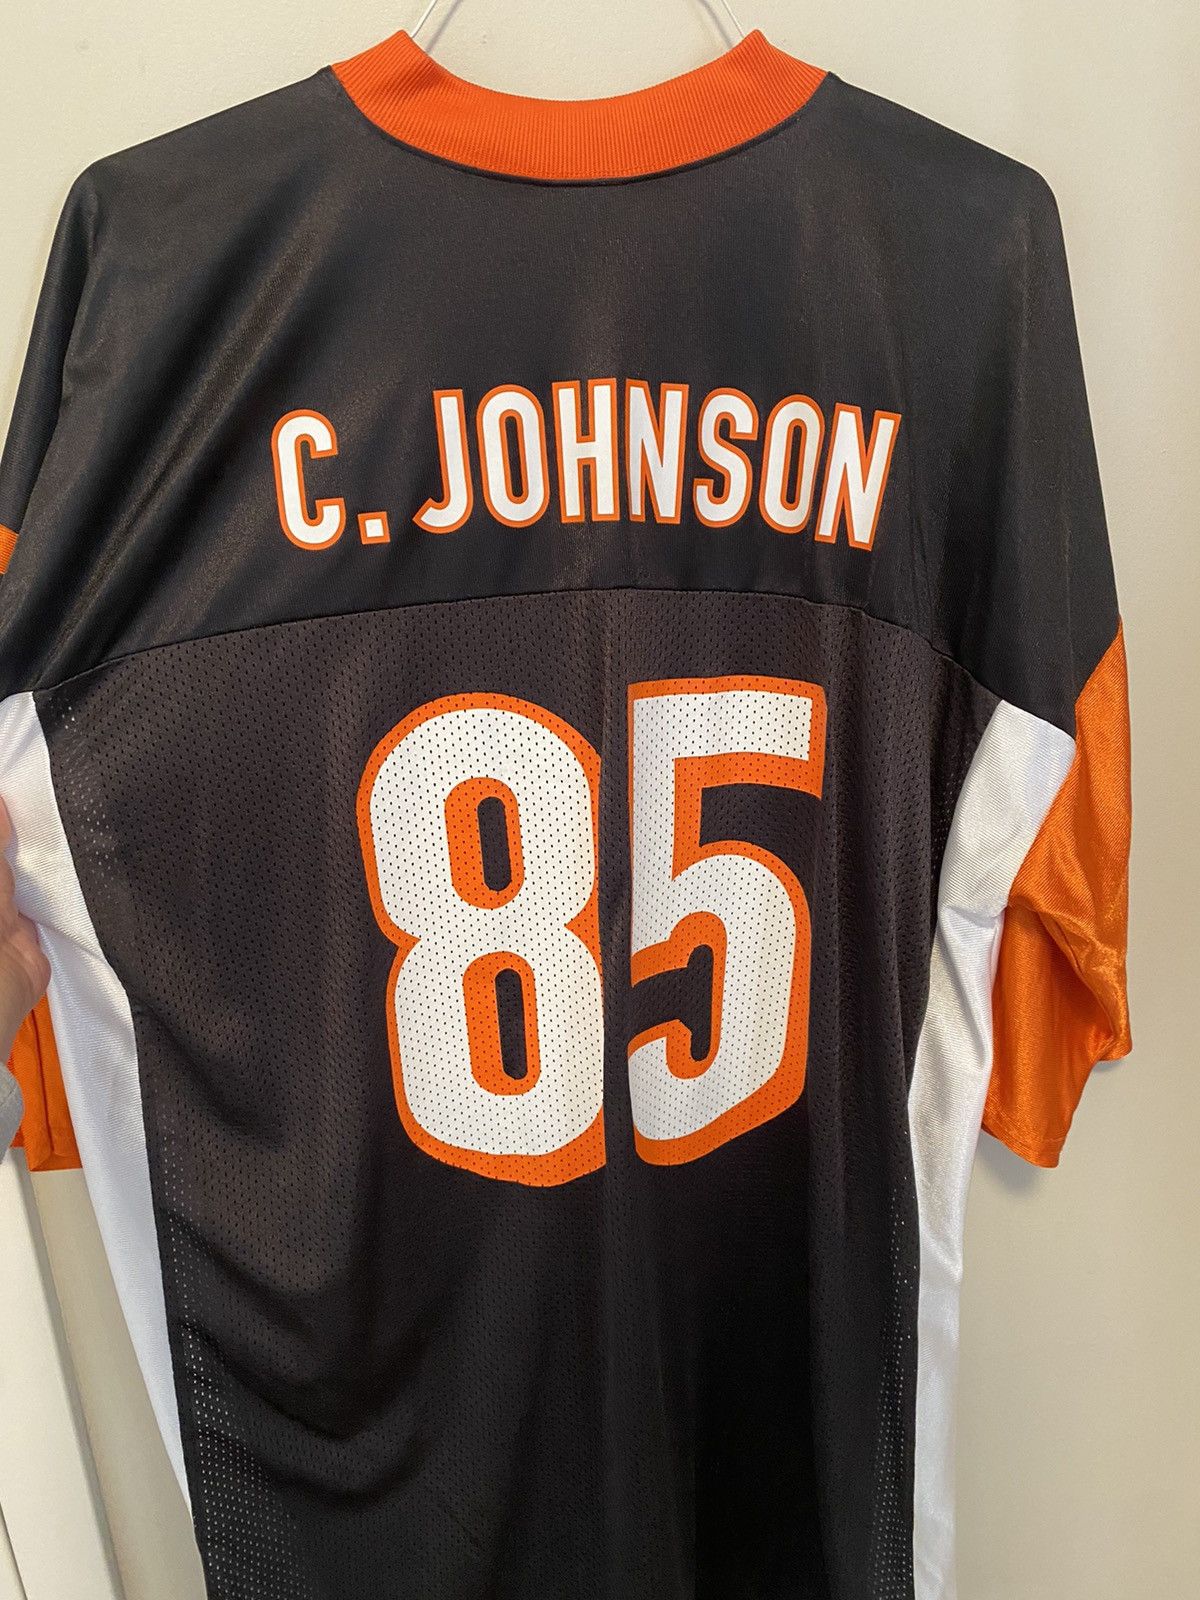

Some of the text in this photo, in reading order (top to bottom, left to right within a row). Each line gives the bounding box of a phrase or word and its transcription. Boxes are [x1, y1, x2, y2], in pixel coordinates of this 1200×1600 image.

[271, 377, 902, 552] C. JOHNSON
[355, 675, 828, 1188] 85
